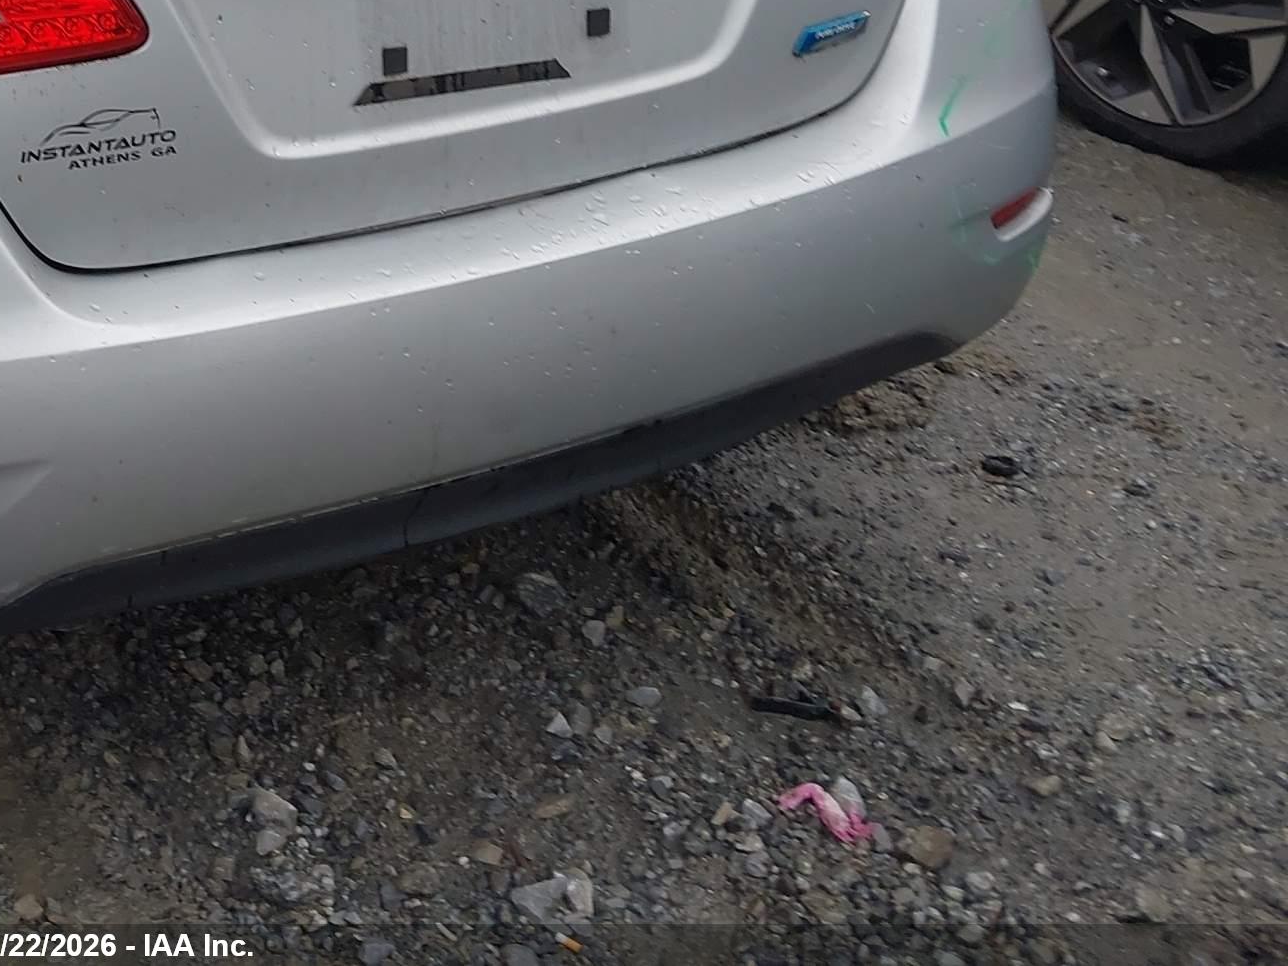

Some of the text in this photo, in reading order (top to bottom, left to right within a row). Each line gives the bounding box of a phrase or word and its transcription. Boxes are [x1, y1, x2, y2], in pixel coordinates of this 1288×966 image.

[20, 130, 177, 164] INSTANTAUTO
[68, 145, 178, 170] ATHENS GA
